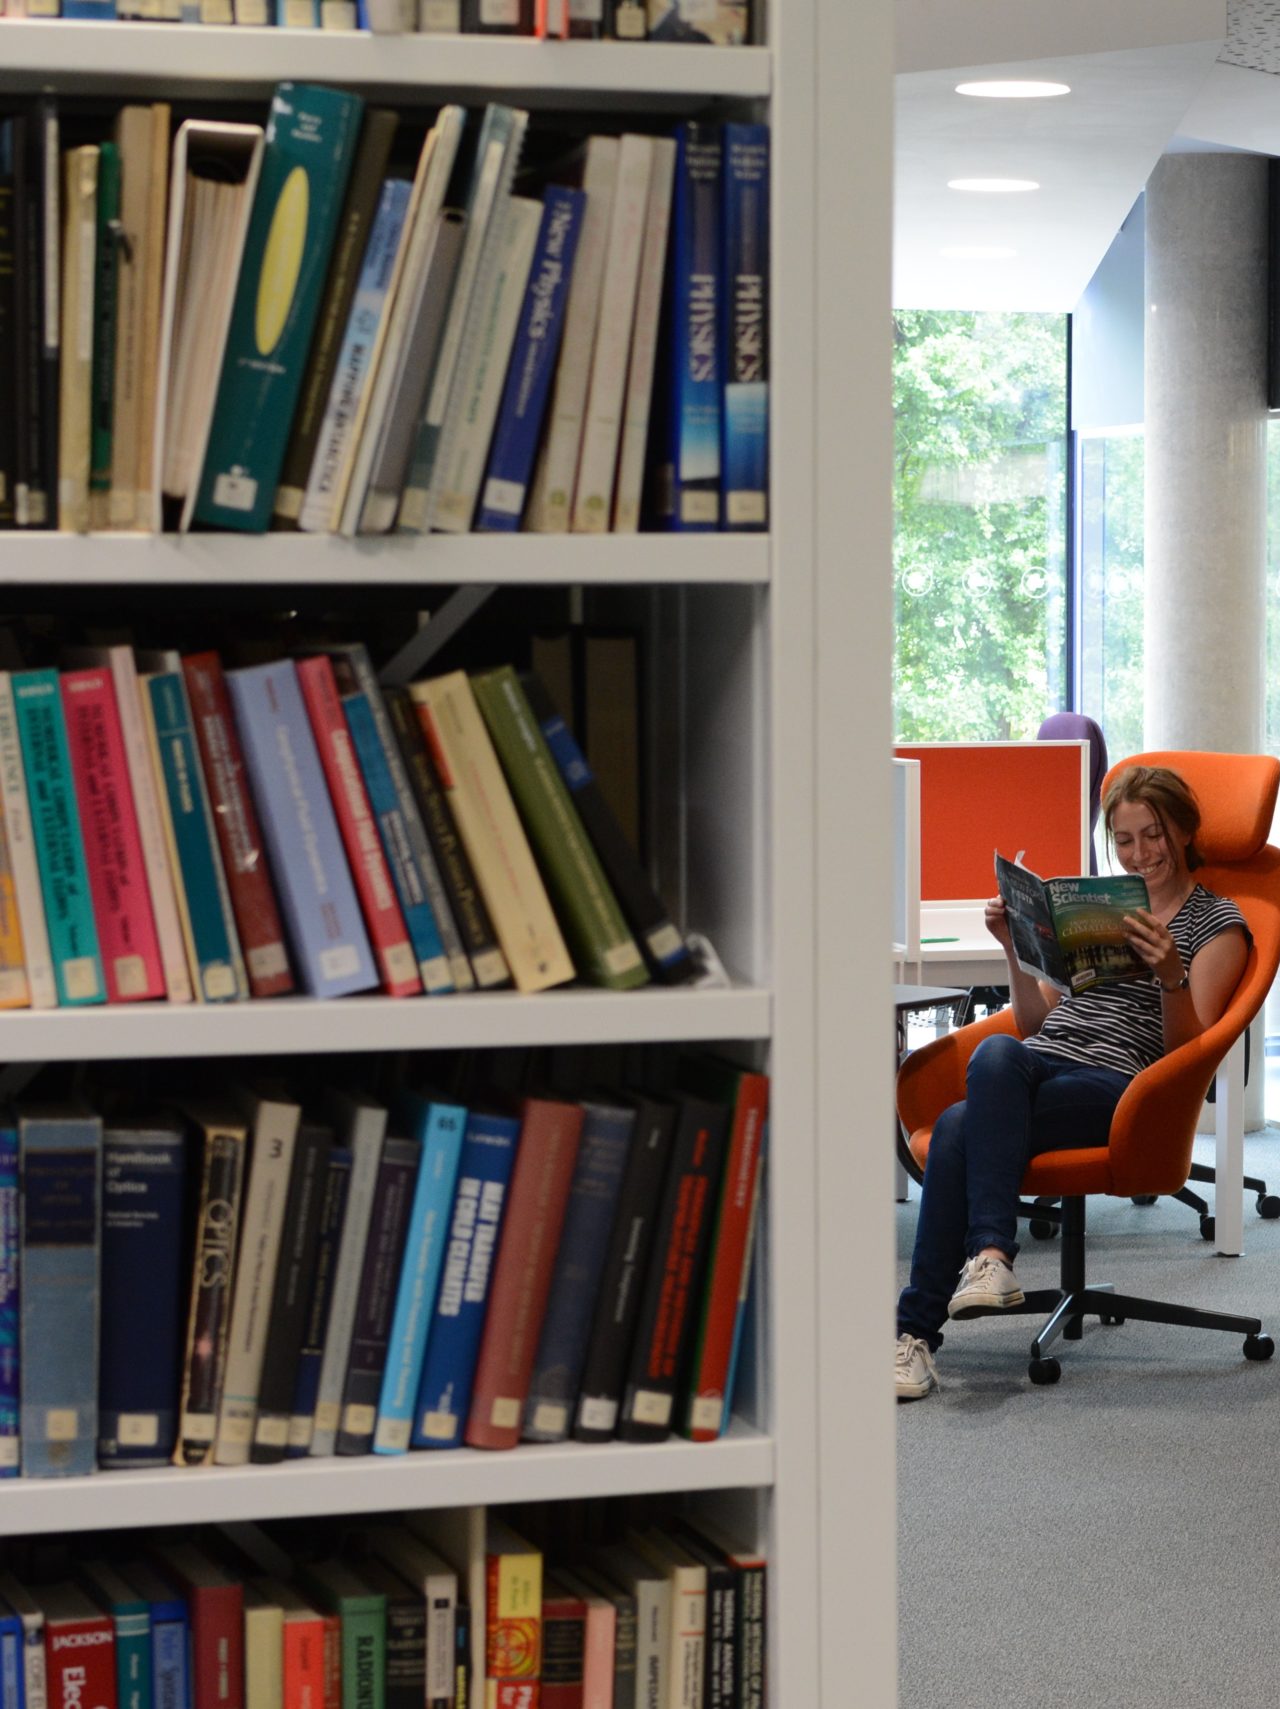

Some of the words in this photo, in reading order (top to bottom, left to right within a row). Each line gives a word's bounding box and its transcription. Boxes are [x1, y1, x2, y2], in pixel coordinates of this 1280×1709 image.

[547, 207, 573, 259] New
[529, 260, 564, 342] Physics
[690, 275, 717, 384] PHYSICS
[736, 275, 764, 384] PHYSICS
[331, 728, 369, 818] Computational
[294, 799, 314, 831] Fluid
[356, 819, 380, 850] Fluid
[366, 851, 393, 911] Dynamics
[1049, 881, 1079, 895] New
[1052, 892, 1111, 907] Scientist
[107, 1151, 173, 1166] Handbook
[269, 1138, 284, 1159] 3
[107, 1166, 123, 1178] of
[460, 1177, 482, 1196] IN
[452, 1197, 477, 1239] COLD
[481, 1180, 505, 1222] HEAT
[200, 1198, 235, 1288] OPTICS
[463, 1222, 498, 1303] TRANSFER
[439, 1240, 470, 1317] CLIMATES
[53, 1630, 114, 1652] JACKSON
